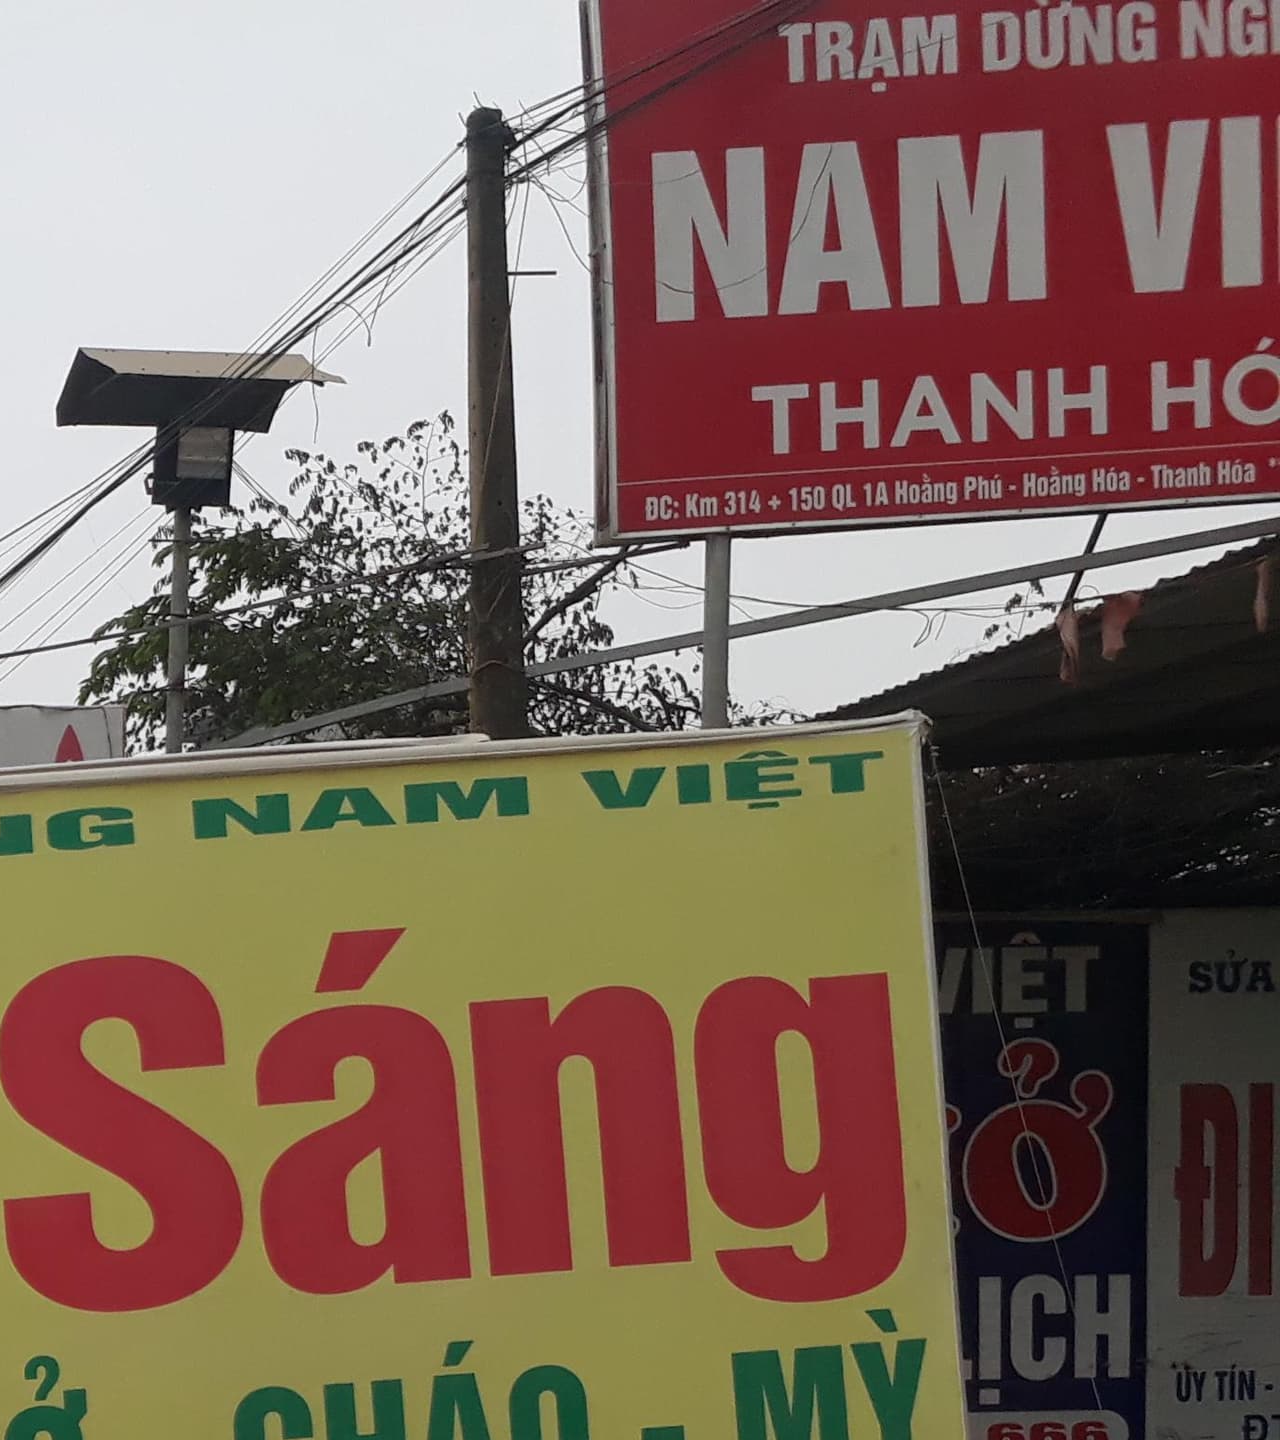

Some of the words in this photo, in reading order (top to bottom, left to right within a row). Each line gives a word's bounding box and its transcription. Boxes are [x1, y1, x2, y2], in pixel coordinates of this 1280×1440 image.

[777, 14, 959, 93] TRẠM
[651, 129, 1048, 323] NAM
[1106, 115, 1280, 294] VI
[751, 364, 1108, 455] THANH
[645, 495, 679, 521] ĐC:
[685, 493, 718, 518] Km
[724, 489, 762, 516] 314
[788, 486, 826, 512] 150
[831, 484, 857, 511] QL
[863, 481, 889, 507] 1A
[964, 475, 1002, 500] Phú
[1092, 467, 1132, 493] Hóa
[1151, 463, 1212, 489] Thanh
[1217, 459, 1257, 486] Hóa
[192, 775, 533, 841] NAM
[582, 750, 885, 812] VIỆT
[1188, 949, 1276, 993] SỬA
[1174, 1083, 1274, 1296] ĐI
[961, 1273, 1130, 1405] ỊCH
[1214, 1363, 1256, 1401] TÍN
